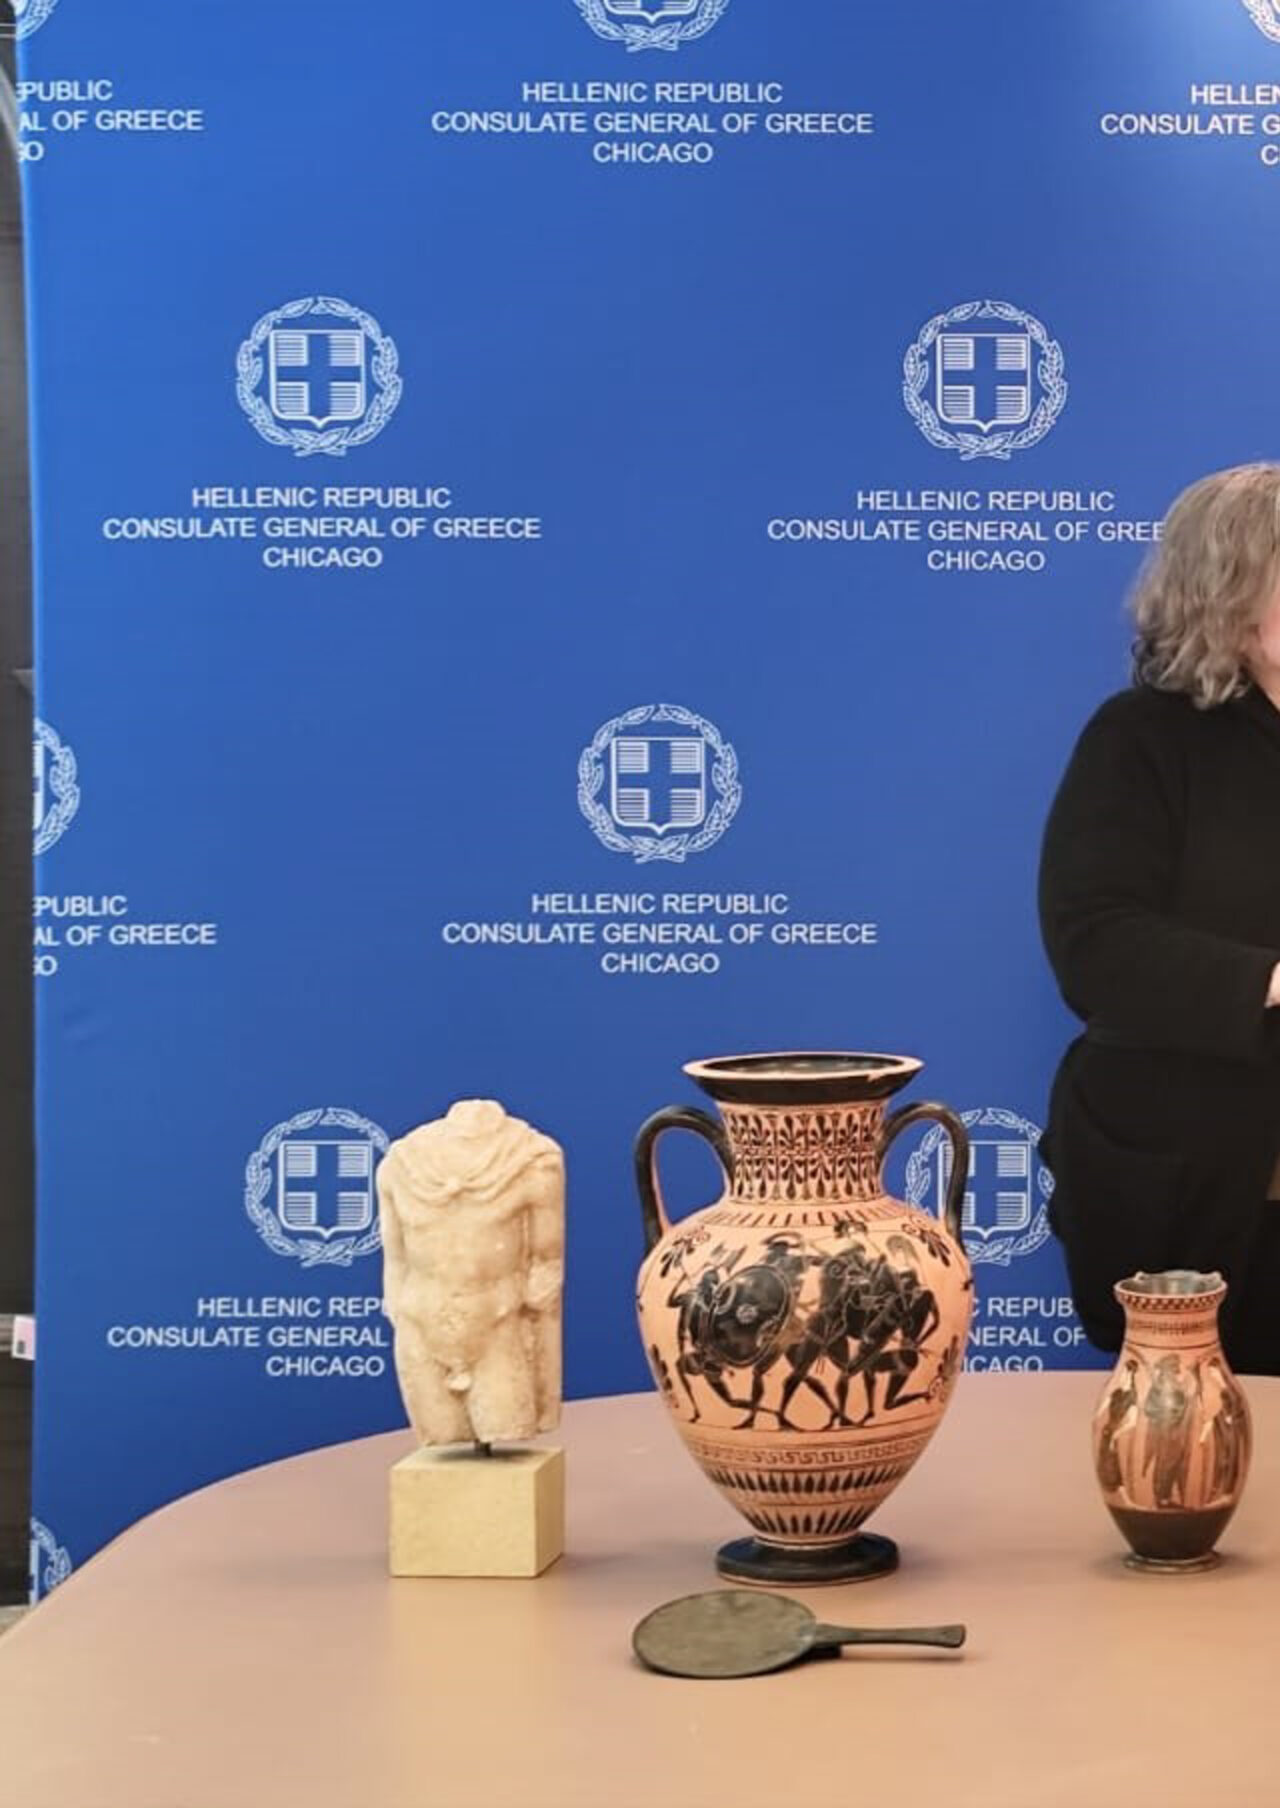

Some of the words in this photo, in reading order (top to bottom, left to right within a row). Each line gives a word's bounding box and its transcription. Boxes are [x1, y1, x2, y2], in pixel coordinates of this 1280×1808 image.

[522, 81, 648, 103] HELLENIC
[654, 82, 783, 104] REPUBLIC
[51, 109, 88, 132] OF
[94, 109, 203, 131] GREECE
[431, 111, 587, 133] CONSULATE
[593, 111, 717, 134] GENERAL
[721, 112, 758, 134] OF
[764, 112, 873, 134] GREECE
[1100, 113, 1255, 135] CONSULATE
[592, 141, 714, 164] CHICAGO
[191, 486, 318, 509] HELLENIC
[323, 486, 451, 509] REPUBLIC
[857, 490, 981, 511] HELLENIC
[988, 490, 1115, 512] REPUBLIC
[102, 517, 257, 540] CONSULATE
[262, 516, 386, 538] GENERAL
[390, 516, 427, 538] OF
[432, 517, 542, 539] GREECE
[767, 519, 921, 541] CONSULATE
[927, 519, 1049, 542] GENERAL
[1054, 520, 1090, 542] OF
[262, 546, 383, 568] CHICAGO
[927, 549, 1046, 571] CHICAGO
[531, 893, 656, 915] HELLENIC
[662, 893, 789, 915] REPUBLIC
[65, 924, 102, 946] OF
[108, 923, 217, 945] GREECE
[442, 922, 596, 944] CONSULATE
[601, 922, 723, 945] GENERAL
[728, 923, 764, 945] OF
[770, 923, 878, 945] GREECE
[600, 952, 721, 974] CHICAGO
[197, 1296, 321, 1318] HELLENIC
[106, 1325, 261, 1348] CONSULATE
[266, 1326, 389, 1348] GENERAL
[1053, 1326, 1086, 1347] OF
[265, 1355, 385, 1377] CHICAGO
